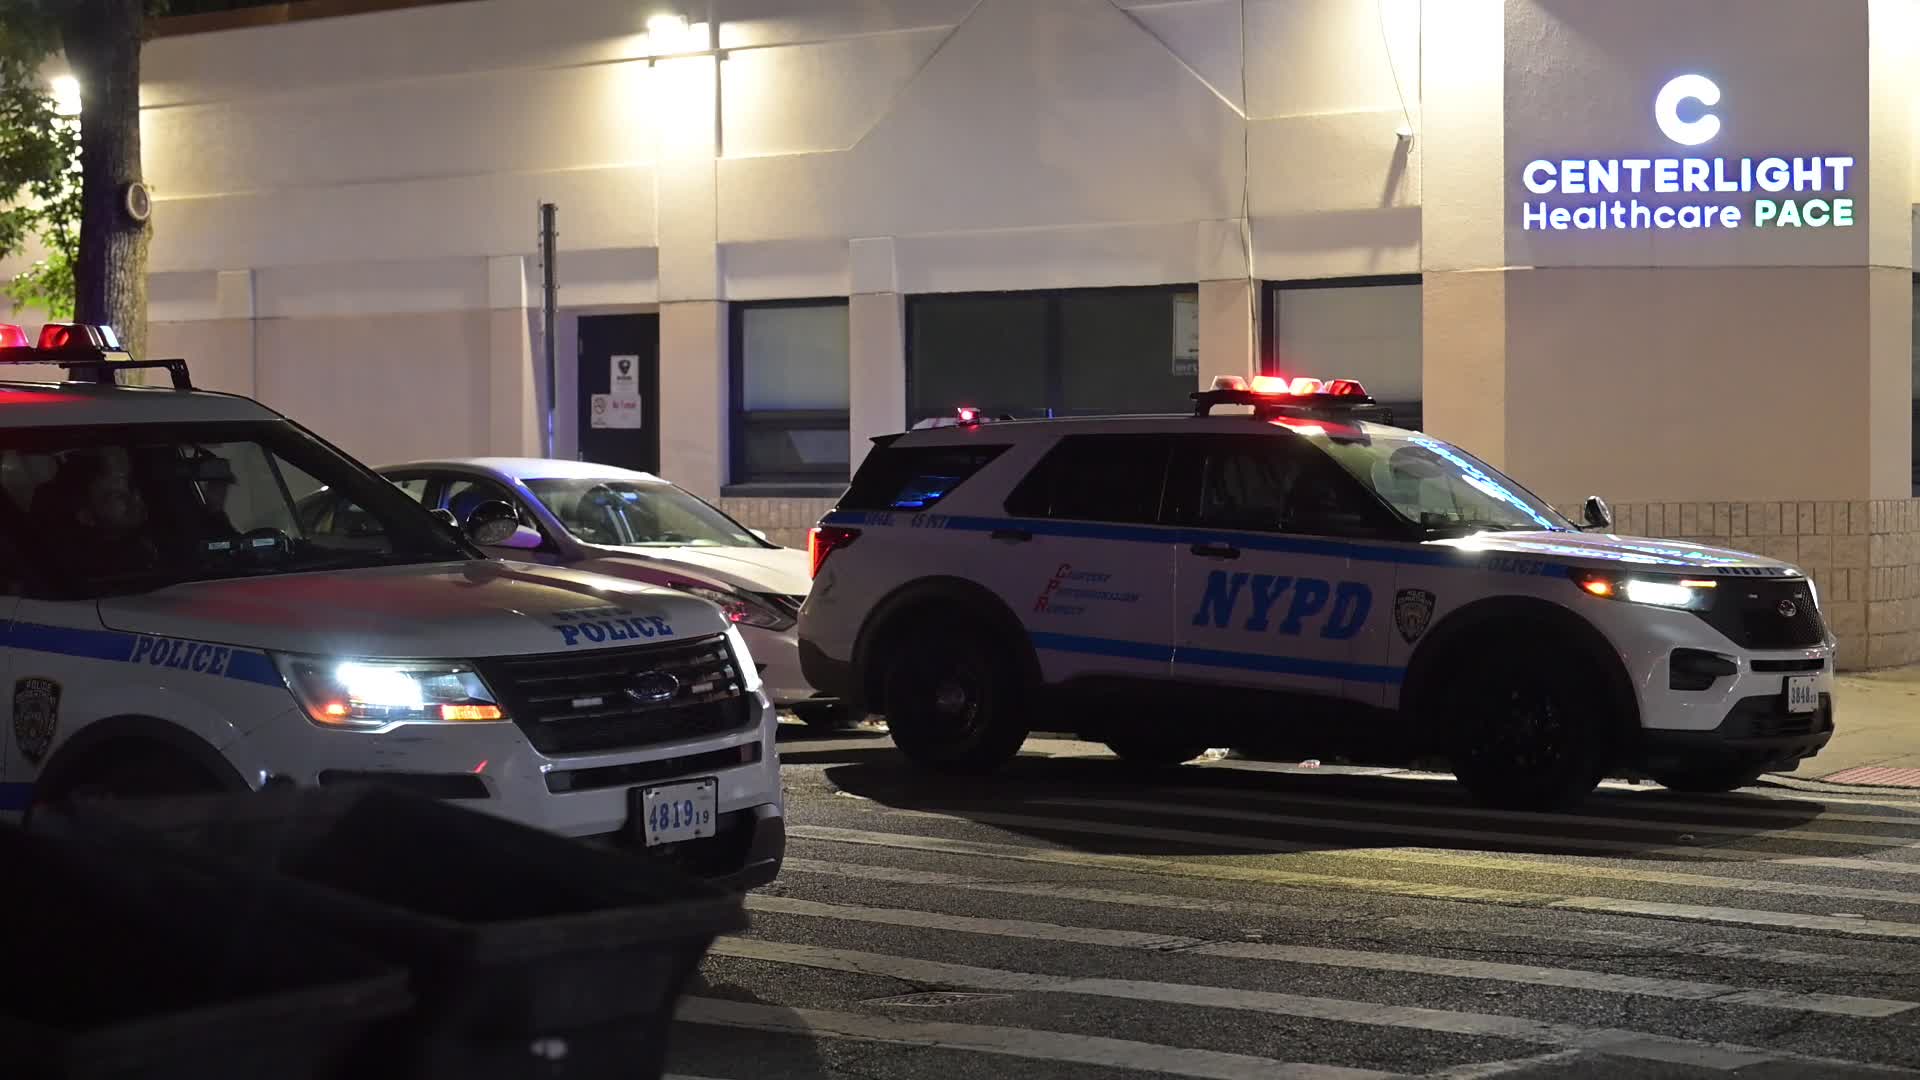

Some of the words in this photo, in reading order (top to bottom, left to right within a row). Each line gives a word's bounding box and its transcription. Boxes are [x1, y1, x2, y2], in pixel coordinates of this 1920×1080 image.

[1523, 157, 1853, 194] CENTERLIGHT
[1523, 200, 1741, 230] Healthcare
[1755, 198, 1854, 227] PACE
[1192, 570, 1373, 640] NYPD
[559, 616, 674, 646] POLICE
[131, 634, 231, 675] POLICE
[1791, 686, 1811, 704] 3848
[650, 800, 694, 832] 4819
[696, 810, 710, 825] 19
